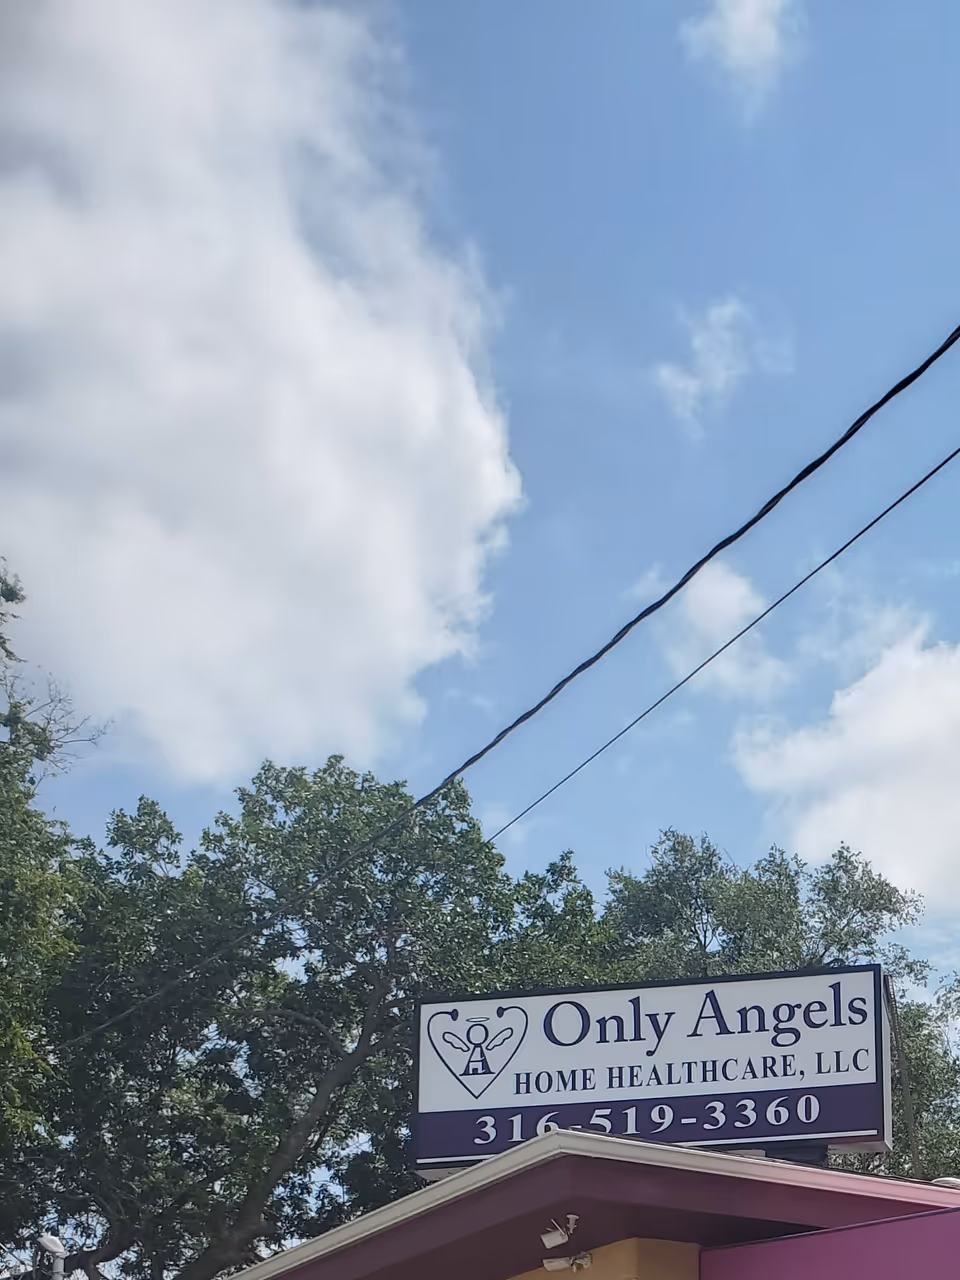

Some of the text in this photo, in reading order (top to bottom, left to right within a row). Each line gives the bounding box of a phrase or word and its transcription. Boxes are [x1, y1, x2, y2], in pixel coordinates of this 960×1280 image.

[543, 981, 868, 1057] Only Angels
[513, 1048, 870, 1096] HOME HEALTHCARE, LLC
[473, 1094, 821, 1145] 316-519-3360
